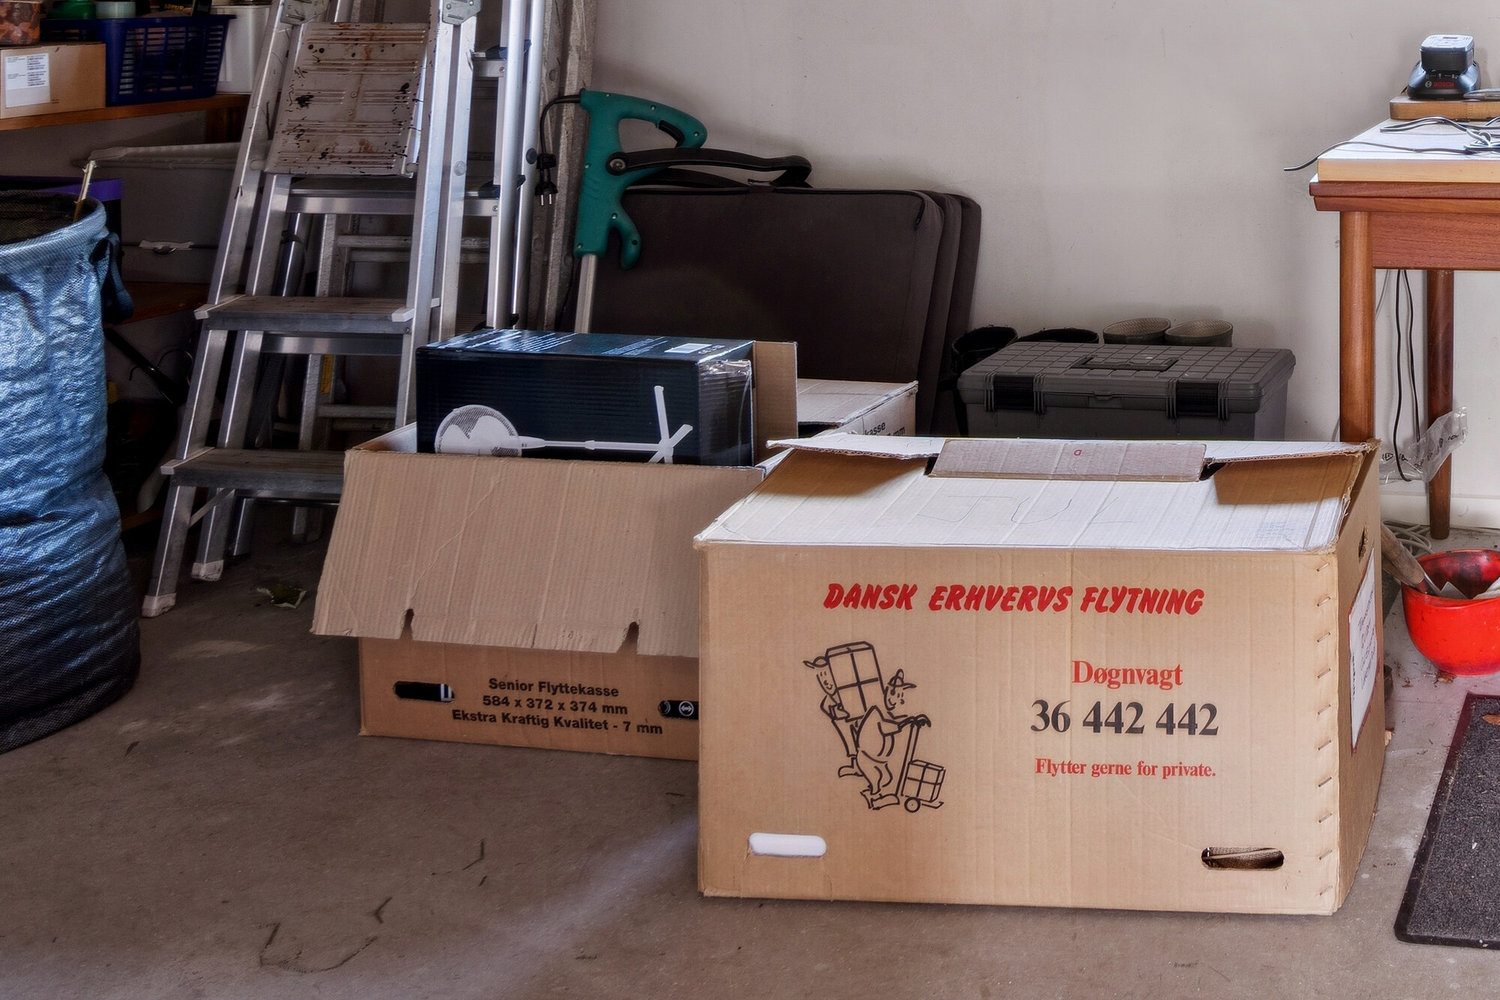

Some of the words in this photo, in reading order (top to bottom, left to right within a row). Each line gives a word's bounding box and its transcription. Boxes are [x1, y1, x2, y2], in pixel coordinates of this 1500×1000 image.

[823, 584, 918, 610] DANSK
[928, 585, 1073, 613] ERHVERVS
[1080, 586, 1204, 615] FLYTNING
[1073, 660, 1183, 689] Døgnvagt
[488, 678, 534, 692] Senior
[538, 681, 619, 697] Flyttekasse
[482, 695, 510, 707] 584
[514, 700, 522, 708] x
[526, 698, 553, 710] 372
[558, 702, 565, 710] x
[570, 700, 597, 712] 374
[602, 704, 628, 714] mm
[452, 710, 497, 722] Ekstra
[501, 712, 550, 728] Kraftig
[553, 716, 608, 731] Kvalitet
[622, 722, 631, 732] 7
[636, 724, 663, 734] mm
[1031, 699, 1071, 733] 36
[1082, 700, 1145, 735] 442
[1155, 702, 1219, 736] 442
[1035, 758, 1087, 778] Flytter
[1092, 763, 1132, 780] gerne
[1137, 761, 1157, 776] for
[1162, 761, 1217, 780] private.
